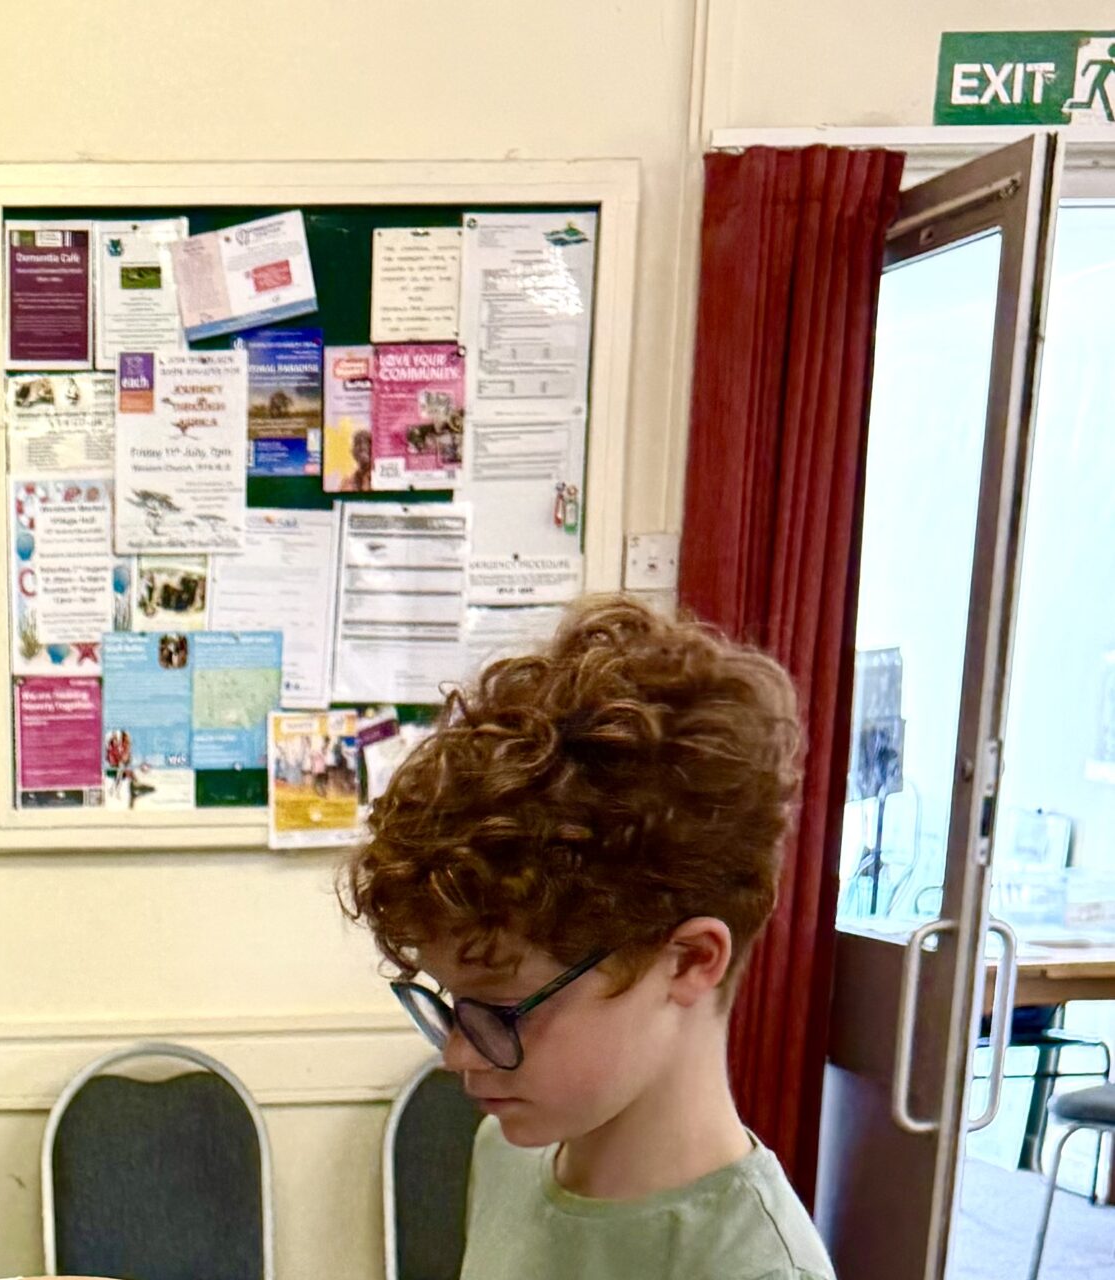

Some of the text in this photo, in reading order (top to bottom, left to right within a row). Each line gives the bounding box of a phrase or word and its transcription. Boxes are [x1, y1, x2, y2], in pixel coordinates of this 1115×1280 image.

[950, 62, 1055, 105] EXIT
[379, 354, 447, 366] LOVE YOUR
[121, 375, 150, 389] each
